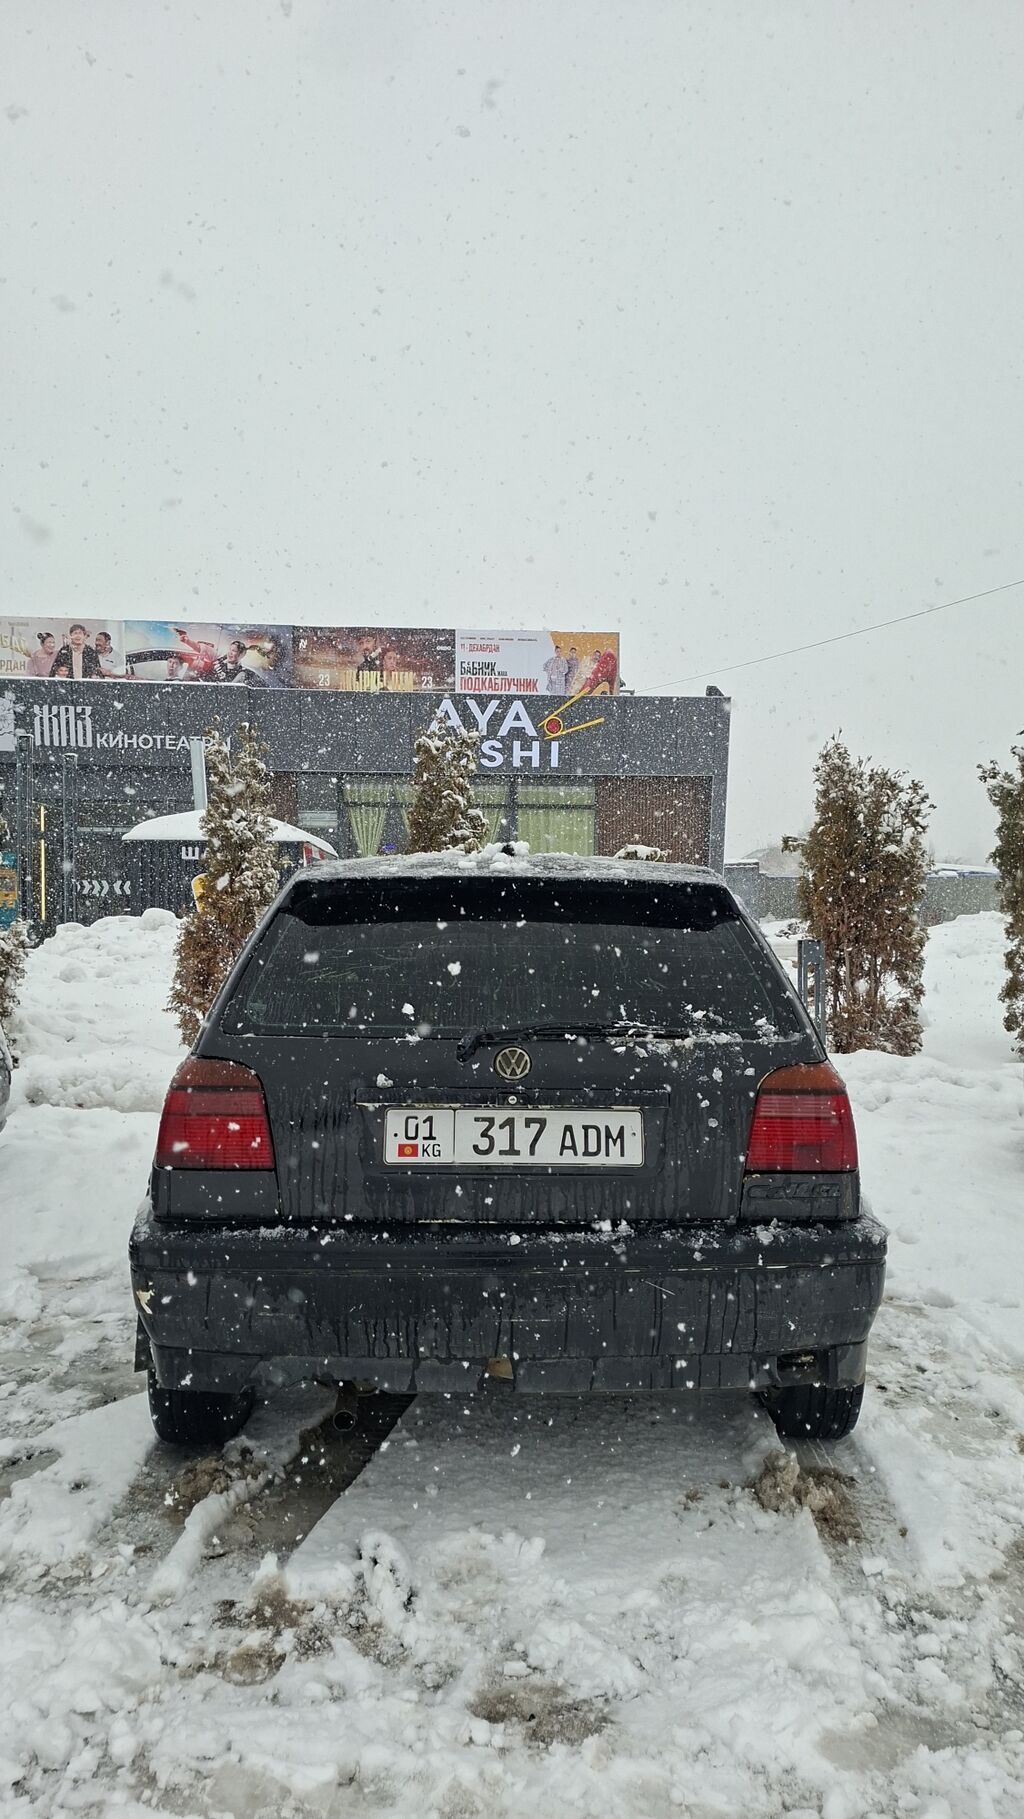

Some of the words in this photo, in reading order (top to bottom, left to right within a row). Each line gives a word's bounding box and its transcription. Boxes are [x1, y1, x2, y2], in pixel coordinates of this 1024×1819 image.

[460, 660, 497, 676] БАБНИК
[318, 673, 331, 687] 23
[421, 676, 433, 689] 23
[460, 677, 539, 693] ПОДКАБЛУЧНИК
[427, 698, 539, 737] AYA
[479, 740, 559, 768] SHI
[404, 1115, 437, 1141] 01
[472, 1116, 548, 1157] 317
[559, 1124, 626, 1158] ADM
[421, 1143, 441, 1158] KG
